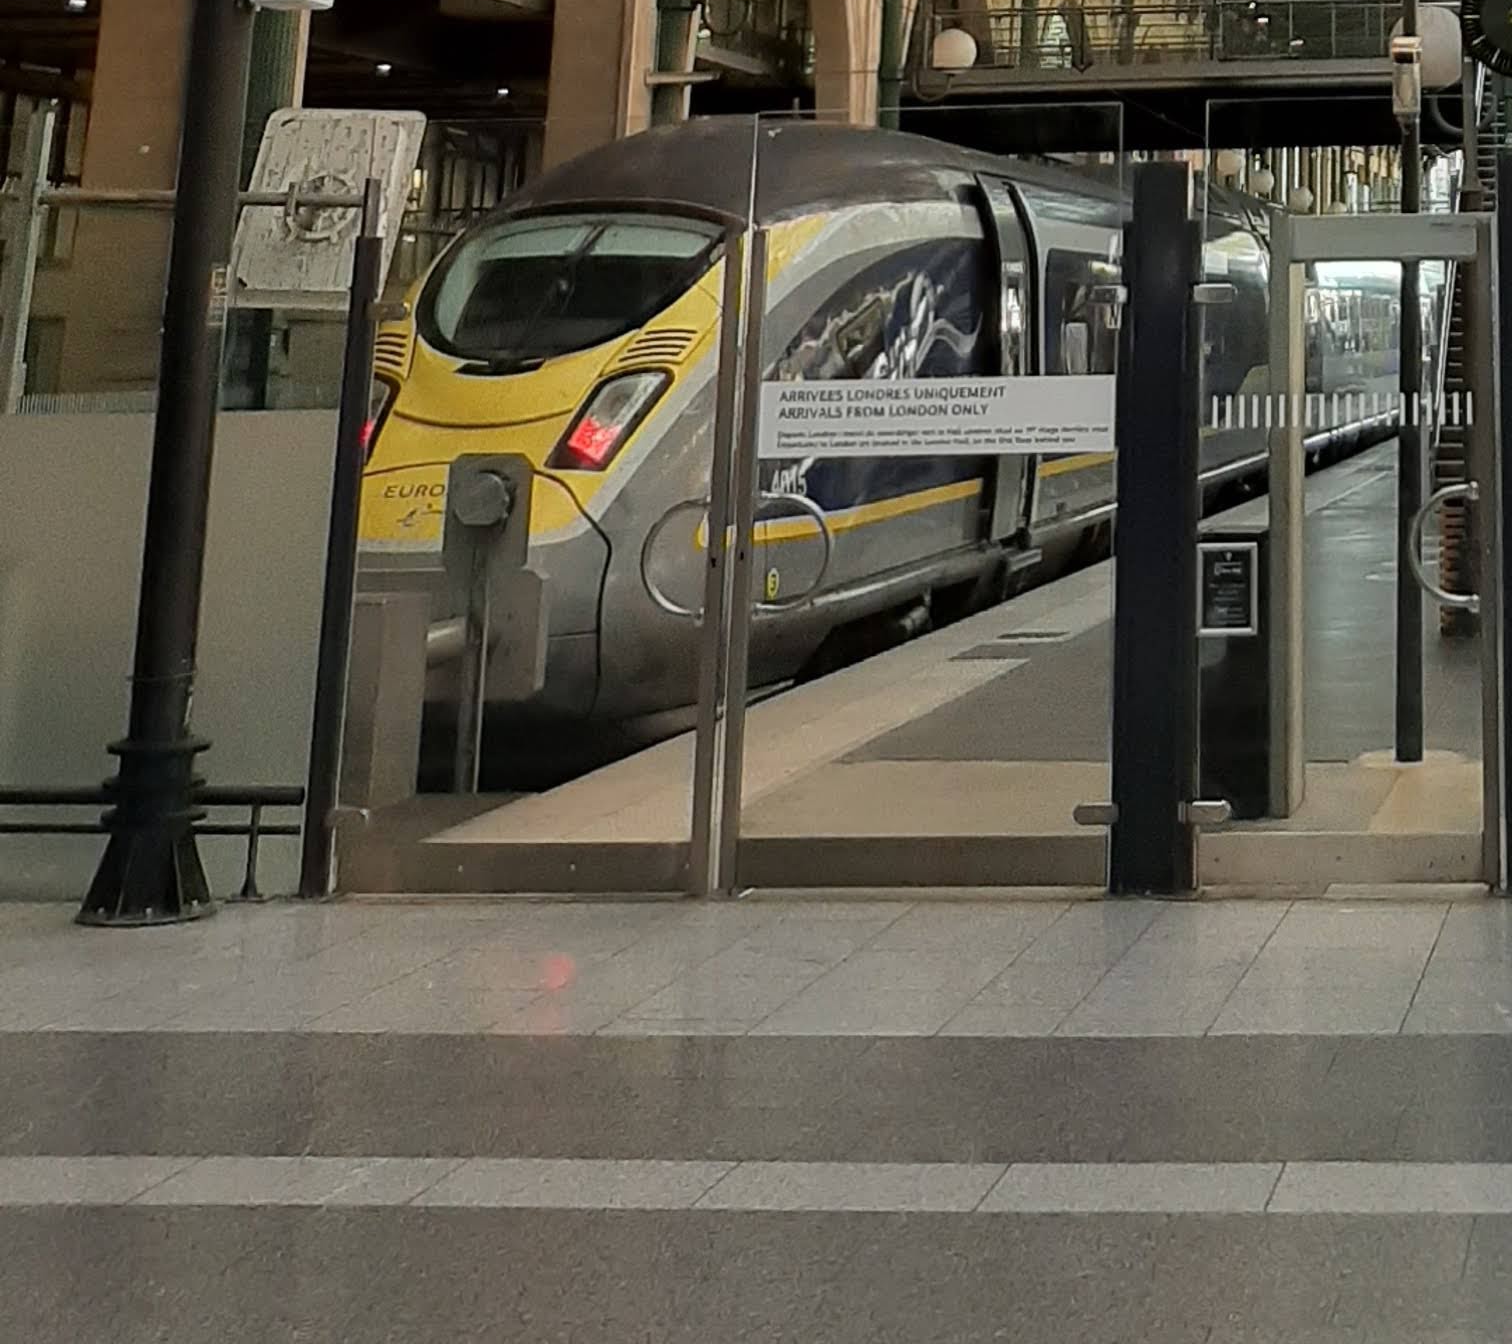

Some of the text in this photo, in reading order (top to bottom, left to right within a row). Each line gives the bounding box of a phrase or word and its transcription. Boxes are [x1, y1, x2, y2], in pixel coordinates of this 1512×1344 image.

[847, 387, 910, 402] LONDRES
[914, 385, 1006, 401] UNIQUEMENT
[778, 403, 989, 419] ARRIVALS FROM LONDON ONLY
[384, 483, 446, 499] EURO
